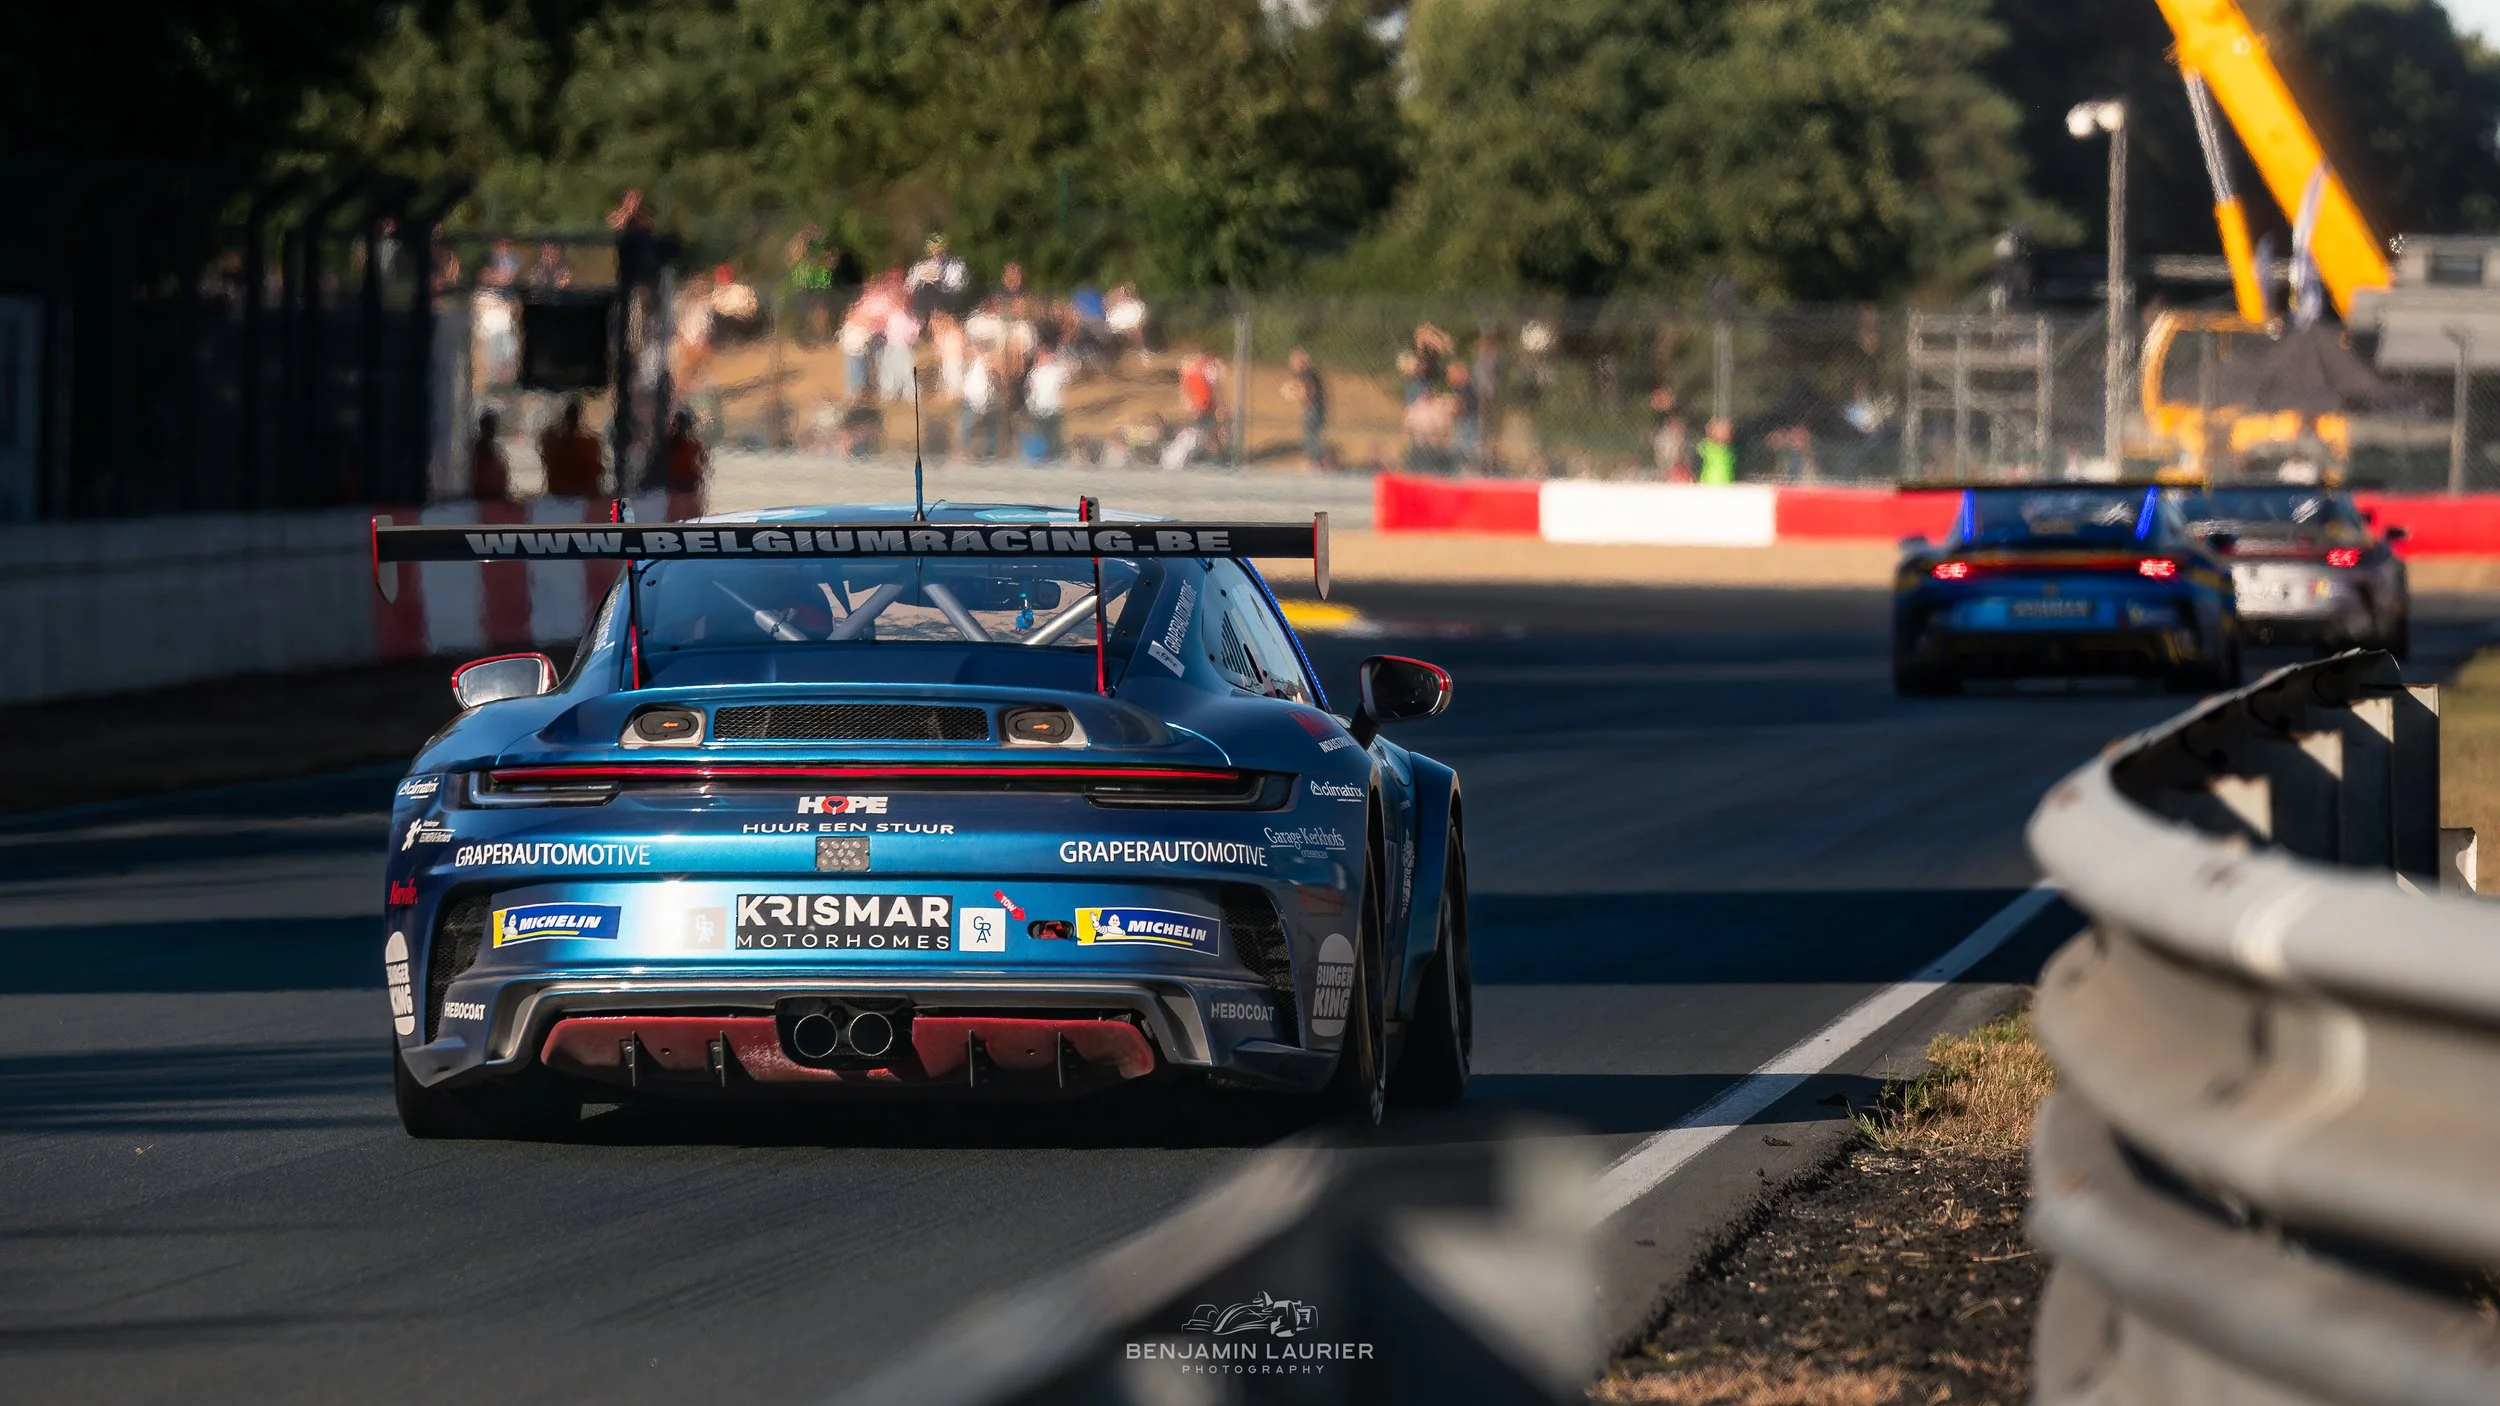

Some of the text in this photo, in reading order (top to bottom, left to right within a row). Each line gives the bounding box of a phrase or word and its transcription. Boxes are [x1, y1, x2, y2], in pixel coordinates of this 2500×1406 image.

[464, 530, 1232, 555] WWW.BELGIUMRACING.BE
[798, 796, 888, 814] HOPE
[742, 822, 955, 834] HUUR EEN STUUR
[1263, 827, 1345, 850] Garage Kerkhofs
[455, 843, 651, 867] GRAPERAUTOMOTIVE
[1059, 841, 1268, 867] GRAPERAUTOMOTIVE
[737, 895, 950, 927] KRISMAR
[999, 895, 1017, 912] TOW
[518, 914, 602, 931] MICHELIN
[1127, 920, 1207, 942] MICHELIN
[736, 934, 950, 949] MOTORHOMES
[443, 1002, 486, 1021] HEBOCOAT
[1211, 1003, 1275, 1022] HEBOCOAT
[1312, 988, 1351, 1017] KING
